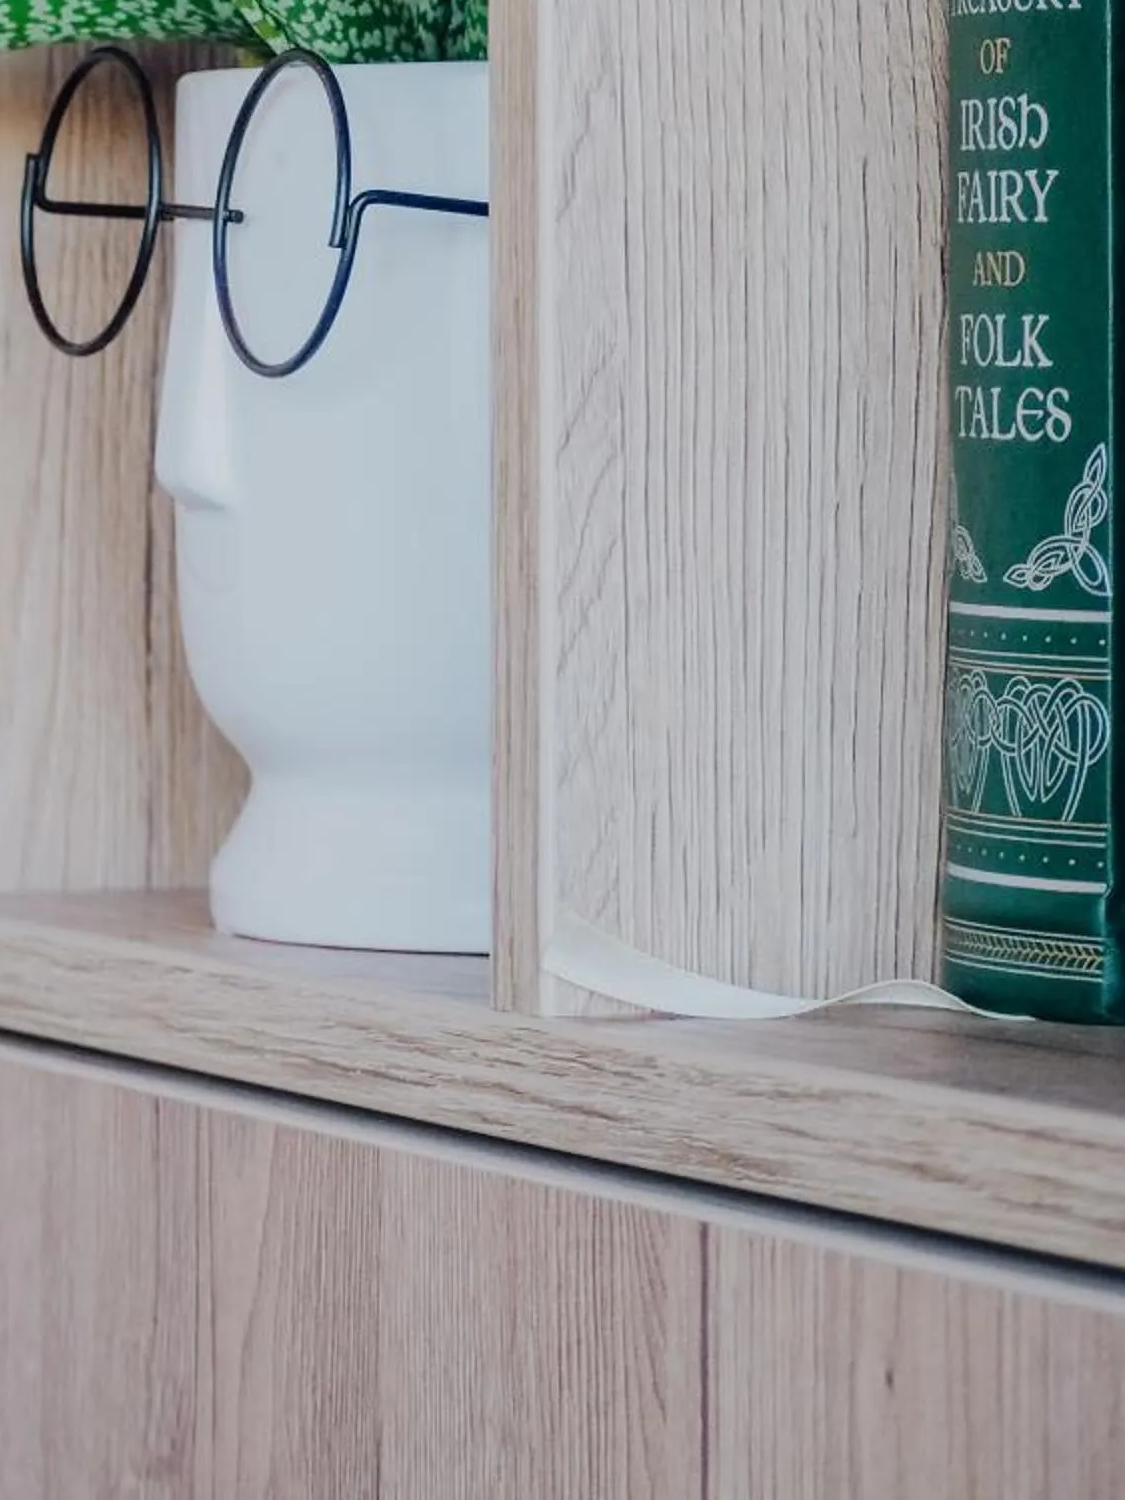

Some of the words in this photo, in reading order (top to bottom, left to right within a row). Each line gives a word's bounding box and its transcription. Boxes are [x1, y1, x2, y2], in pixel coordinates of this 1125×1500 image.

[979, 37, 1012, 75] OF
[956, 169, 1060, 224] FAIRY
[972, 250, 1026, 287] AND
[959, 313, 1054, 368] FOLK
[955, 385, 1073, 443] TALES
